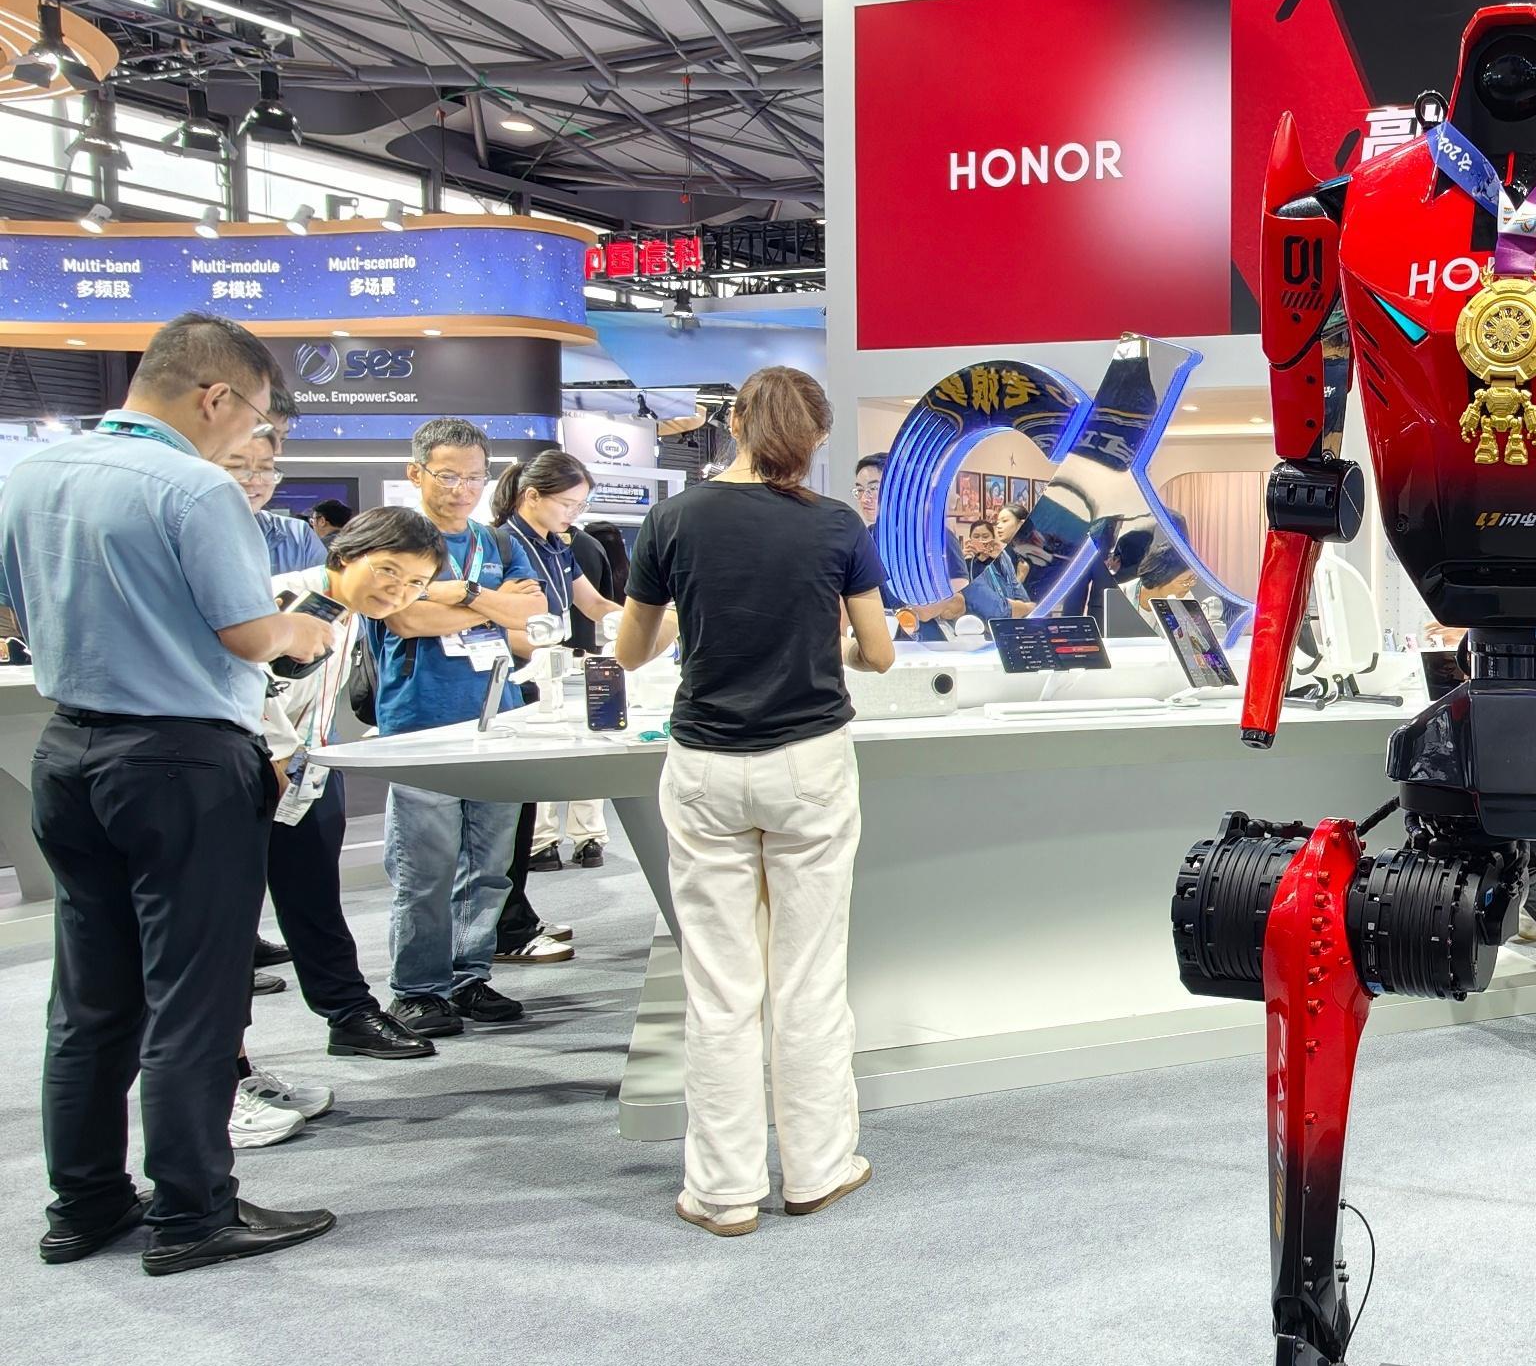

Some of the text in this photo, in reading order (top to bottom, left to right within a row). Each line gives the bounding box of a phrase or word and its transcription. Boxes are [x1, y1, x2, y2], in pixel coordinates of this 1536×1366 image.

[949, 140, 1124, 191] HONOR
[63, 258, 141, 273] Multi-band
[192, 259, 280, 274] Multi-module
[328, 255, 416, 272] Multi-scenario
[76, 280, 132, 299] 多频段
[212, 280, 263, 299] 多模块
[350, 276, 396, 297] 多场景
[294, 390, 330, 403] Solve.
[1276, 1011, 1287, 1172] FLASH
